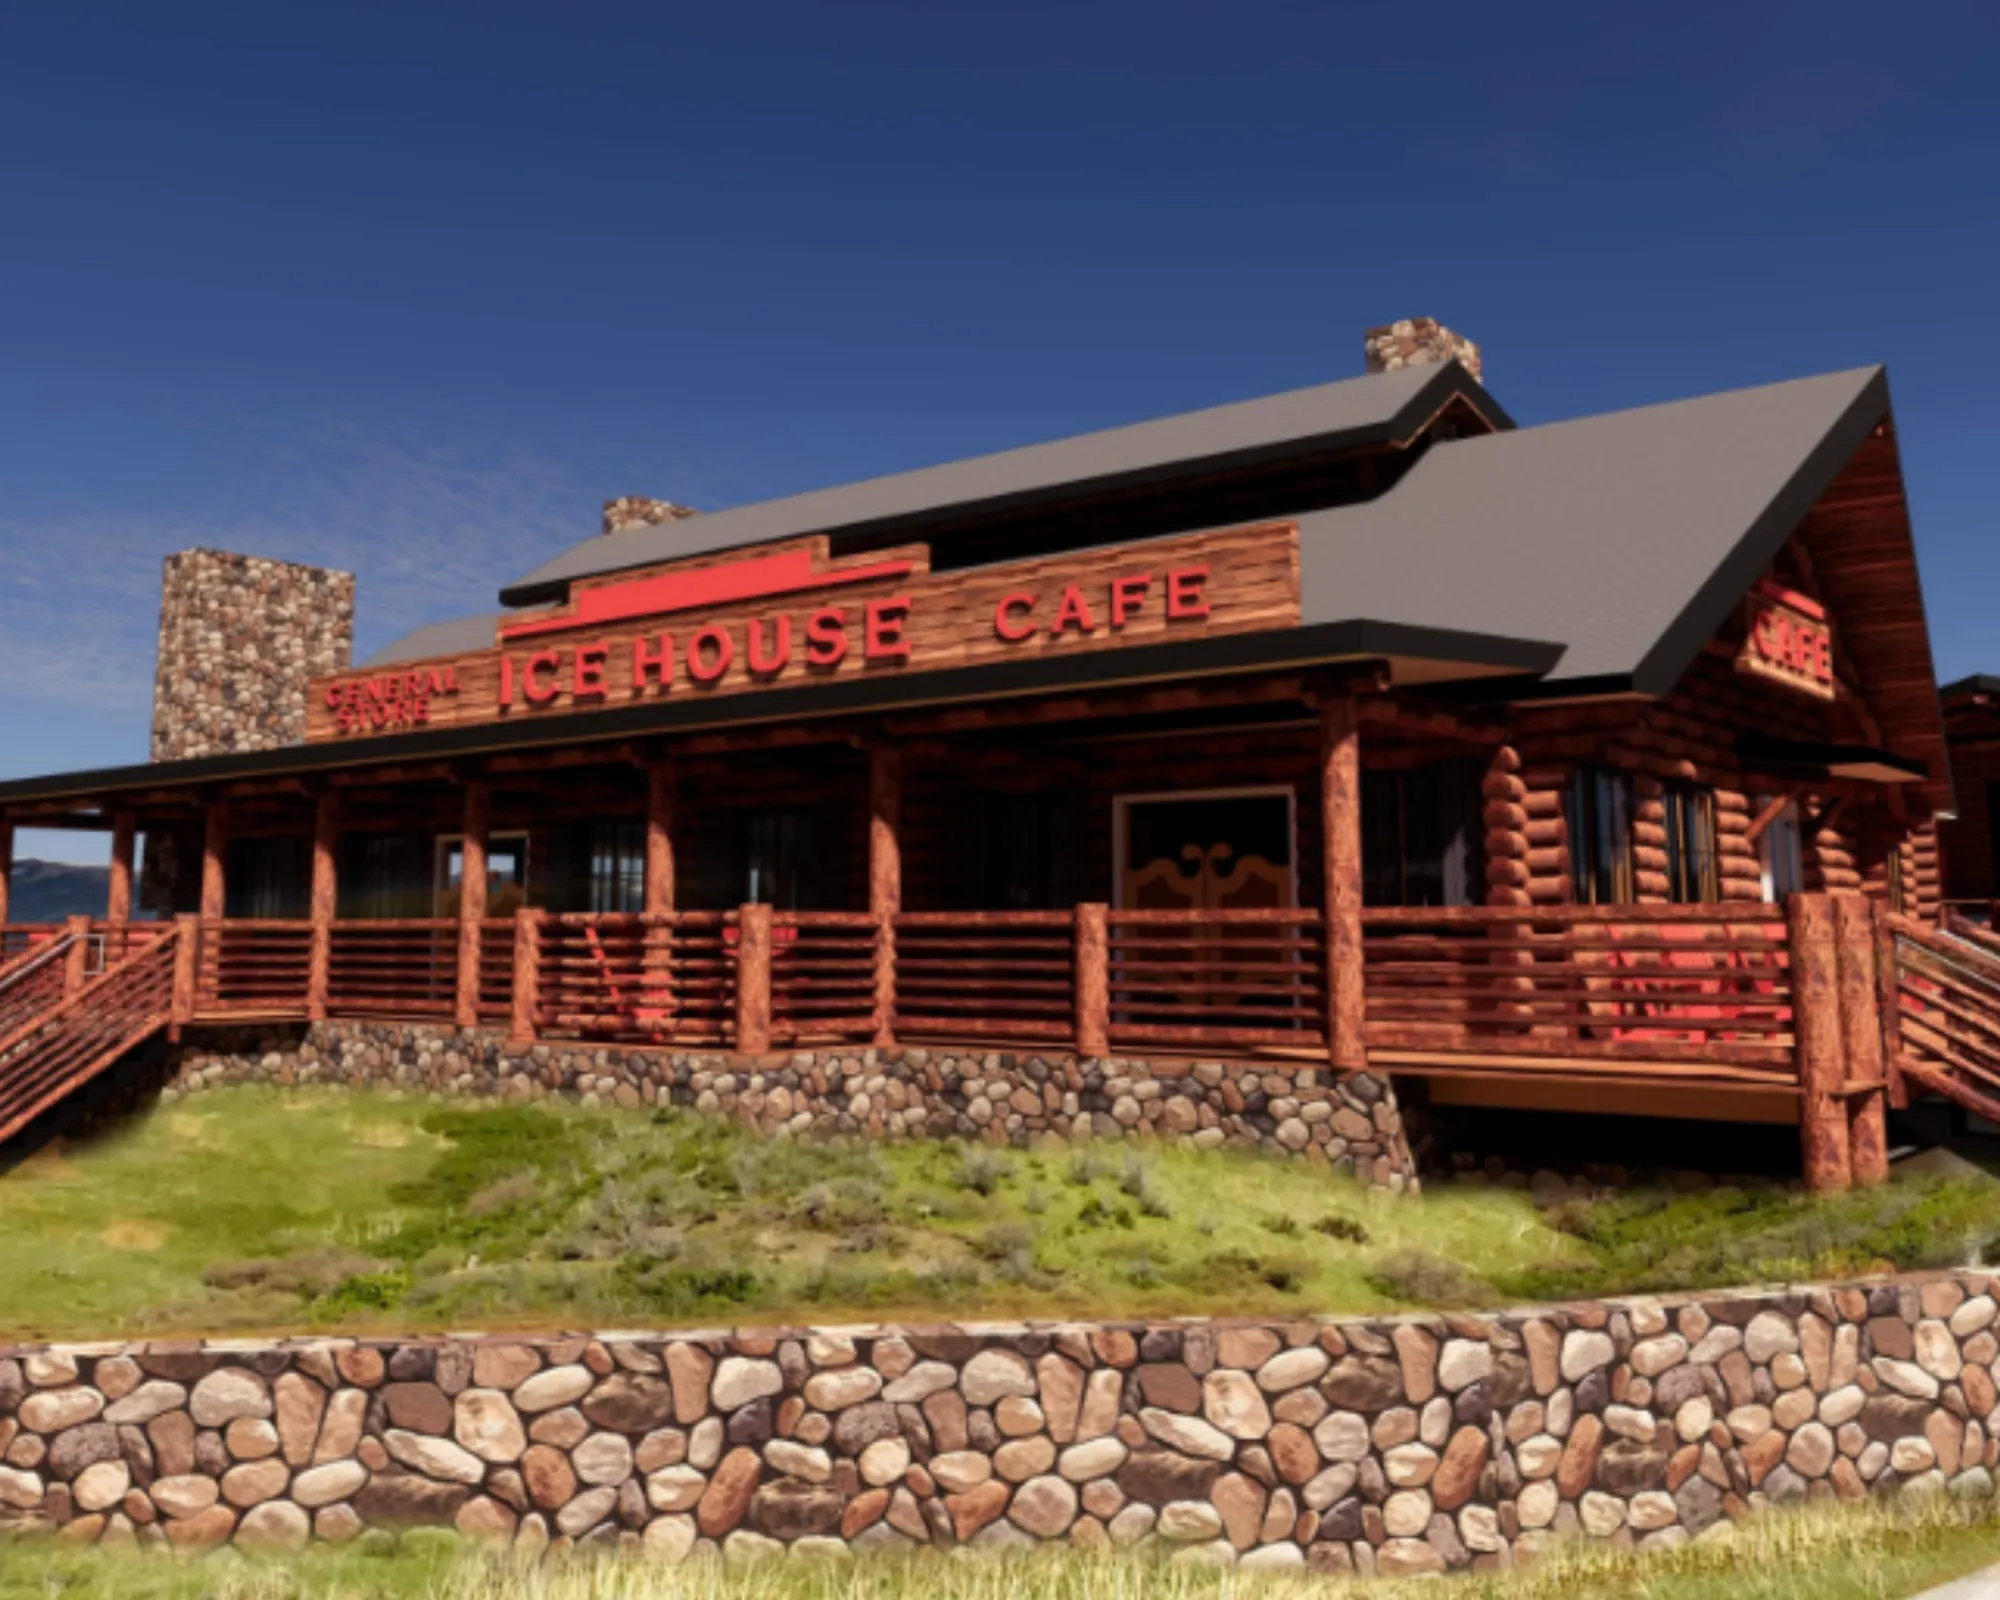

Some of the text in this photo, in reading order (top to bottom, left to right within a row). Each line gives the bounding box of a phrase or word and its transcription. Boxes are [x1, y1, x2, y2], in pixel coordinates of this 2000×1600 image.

[501, 565, 1211, 706] ICE HOUSE CAFE
[1753, 610, 1833, 681] CAFE
[326, 666, 462, 706] GENERAL
